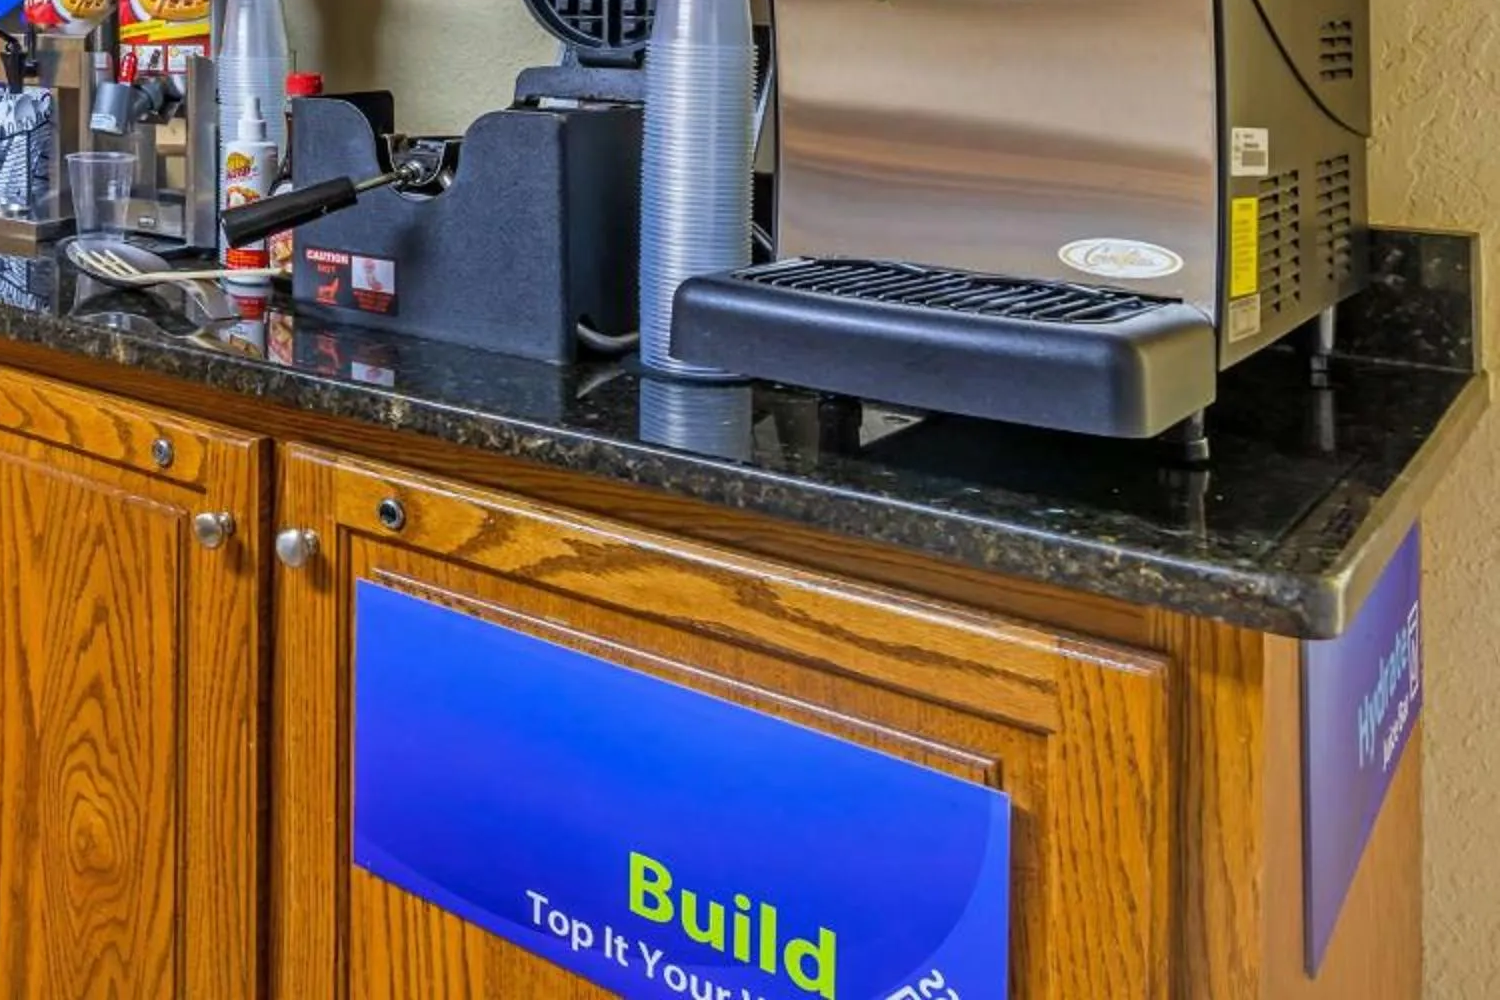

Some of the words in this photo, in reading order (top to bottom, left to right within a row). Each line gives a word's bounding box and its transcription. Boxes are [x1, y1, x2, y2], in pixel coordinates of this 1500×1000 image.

[305, 247, 349, 266] CAUTION
[1358, 625, 1408, 770] Hydrate
[525, 888, 594, 953] Top
[605, 925, 630, 968] It
[638, 940, 732, 1000] Your
[629, 850, 837, 1000] Build
